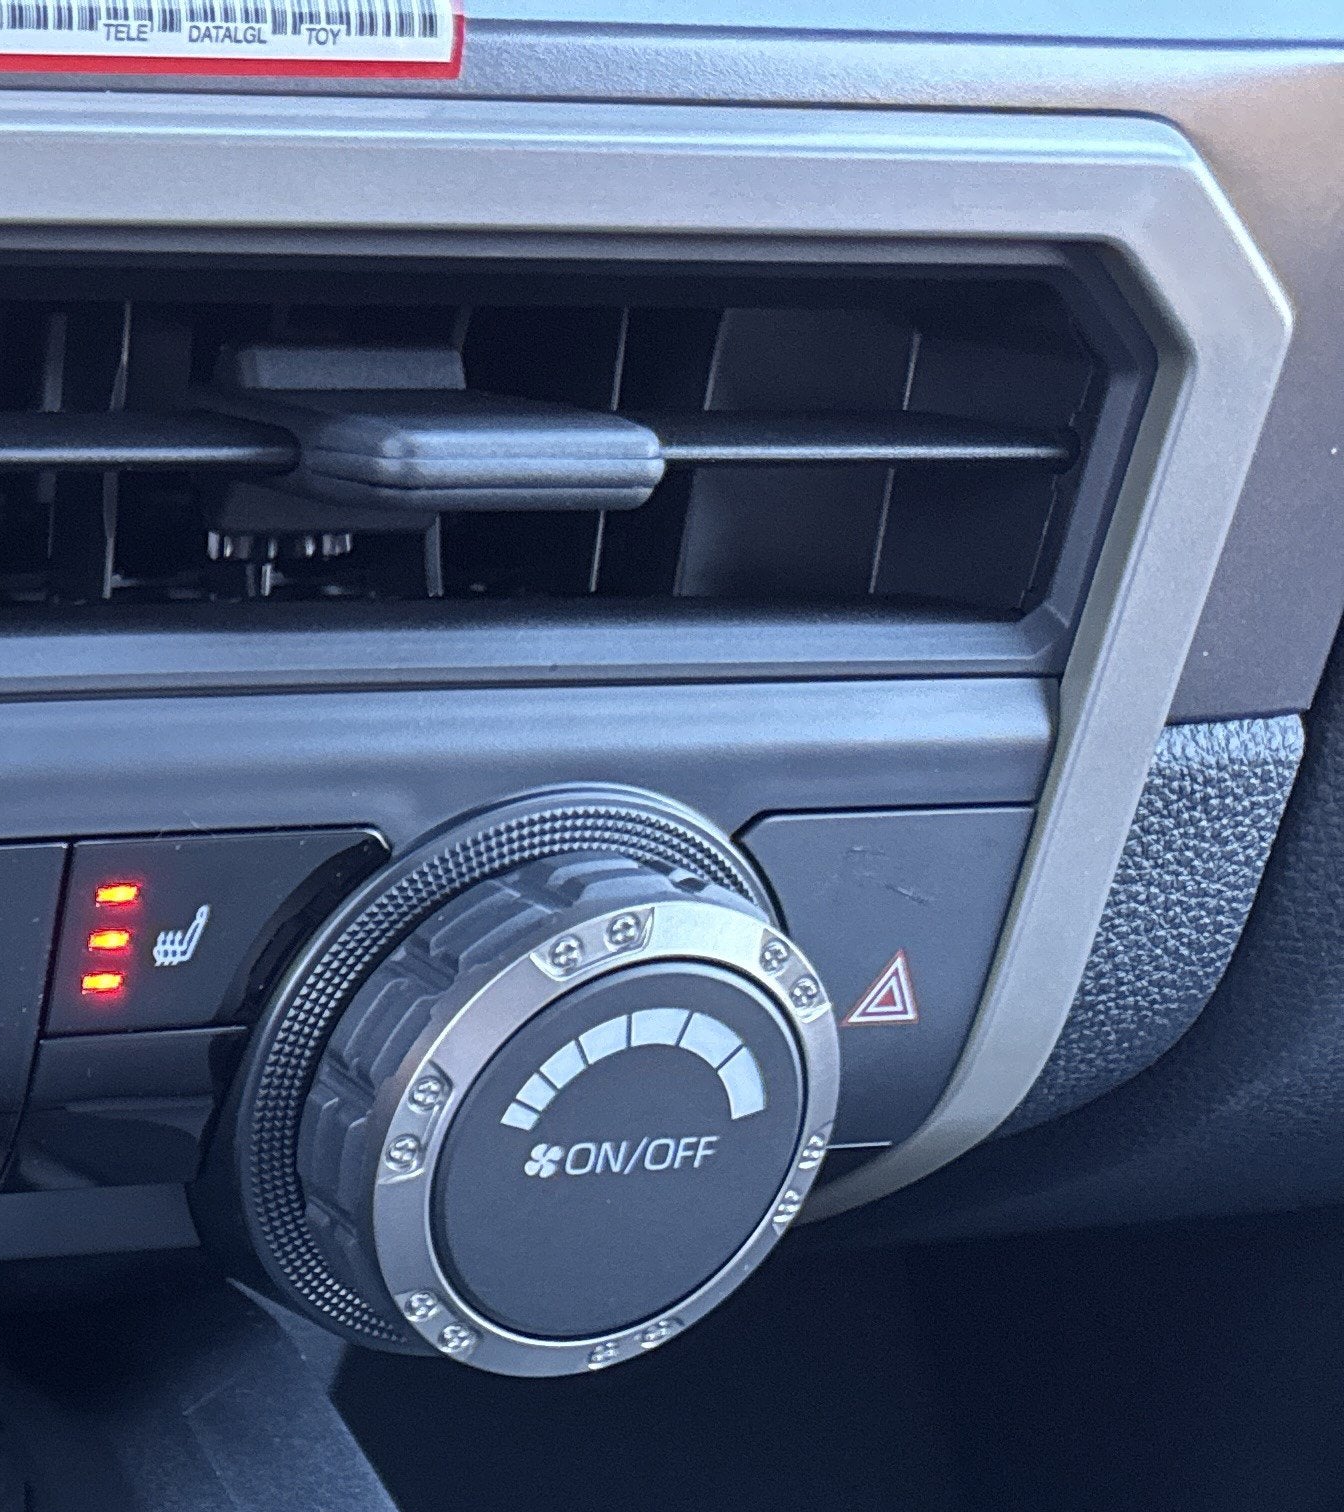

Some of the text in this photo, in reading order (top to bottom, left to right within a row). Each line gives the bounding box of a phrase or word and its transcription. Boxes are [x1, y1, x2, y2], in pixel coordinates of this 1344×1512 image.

[103, 23, 340, 46] TELE DATALGL TOY
[564, 1135, 719, 1176] ON/OFF
